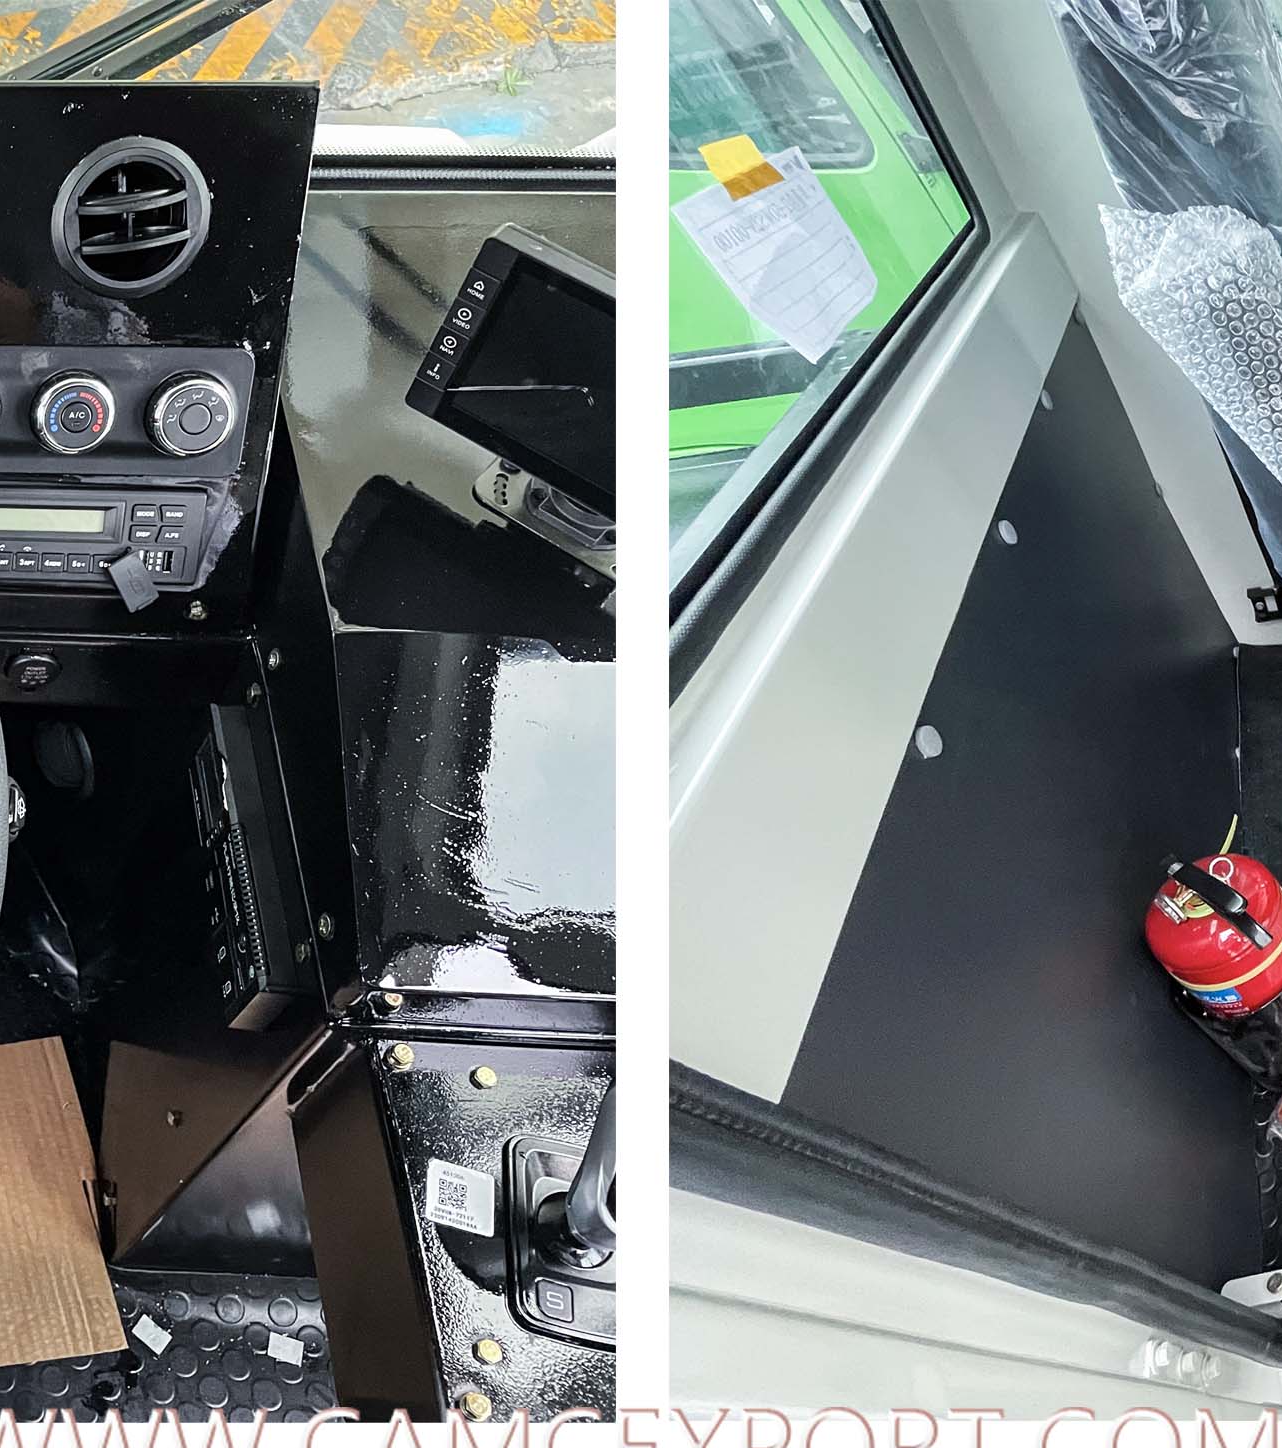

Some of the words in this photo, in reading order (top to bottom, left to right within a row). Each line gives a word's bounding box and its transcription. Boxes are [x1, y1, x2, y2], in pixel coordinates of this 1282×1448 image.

[467, 288, 486, 300] HOME
[452, 317, 470, 330] VIDEO
[439, 345, 454, 356] NAVI
[68, 411, 86, 420] A/C
[546, 1291, 564, 1310] S
